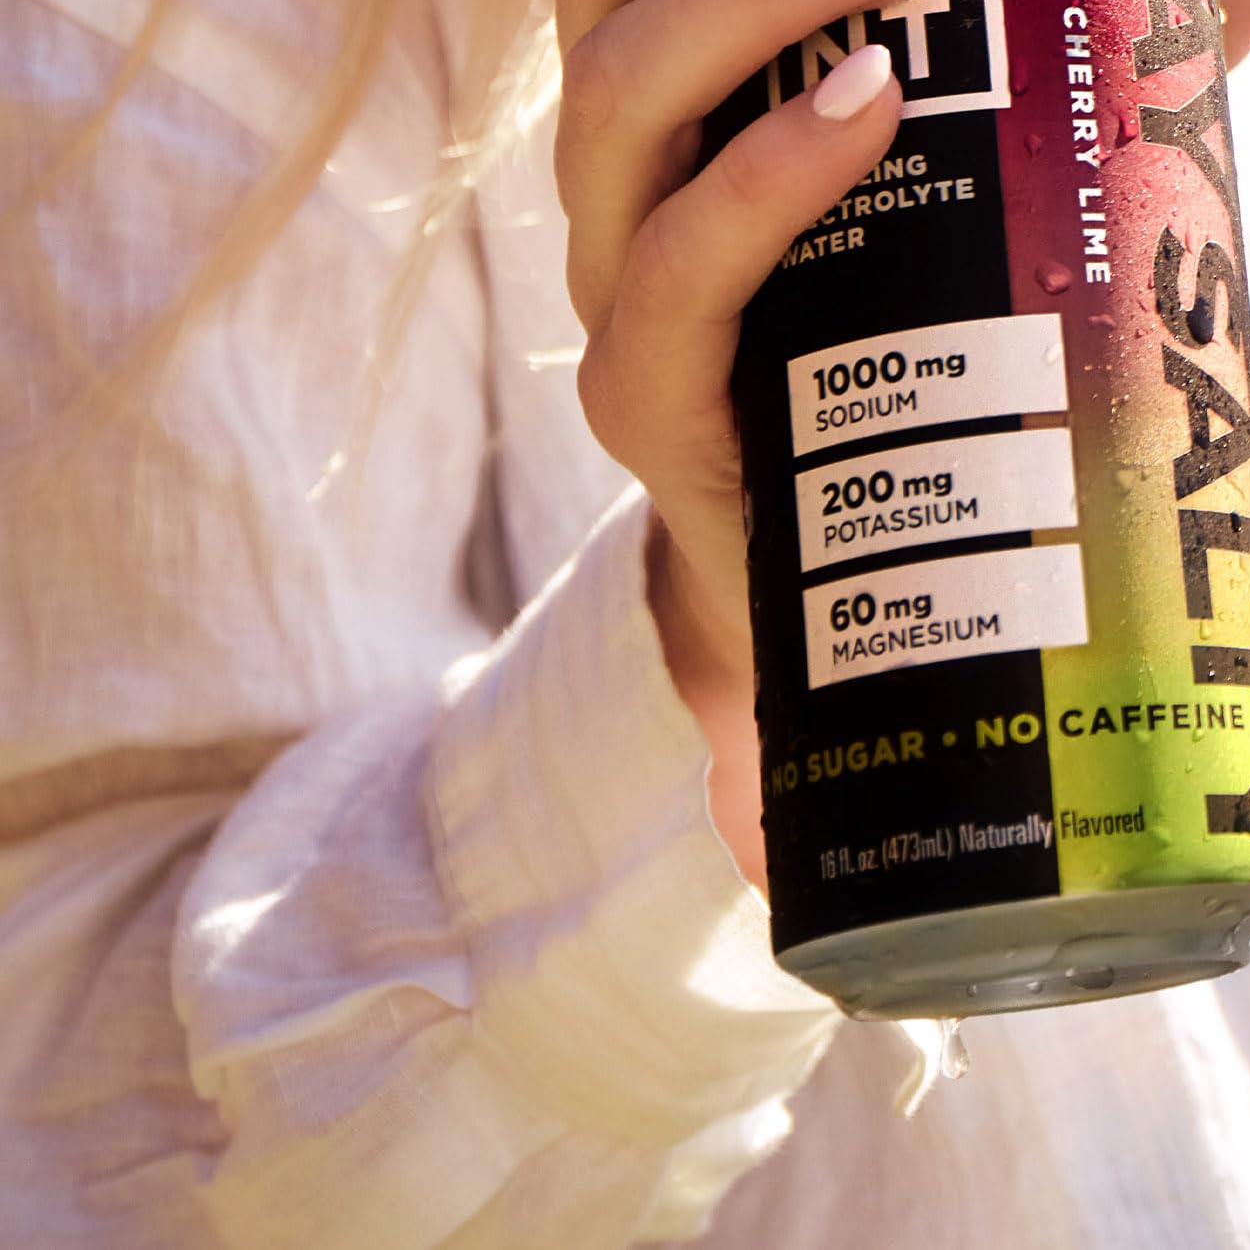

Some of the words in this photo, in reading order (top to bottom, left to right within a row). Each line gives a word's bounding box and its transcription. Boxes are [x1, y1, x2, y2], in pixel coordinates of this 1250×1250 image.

[1063, 6, 1102, 170] CHERRY
[1078, 187, 1111, 284] LIME
[813, 351, 906, 400] 1000
[915, 354, 966, 378] mg
[815, 389, 918, 432] SODIUM
[821, 470, 895, 516] 200
[902, 472, 953, 498] mg
[824, 497, 978, 548] POTASSIUM
[830, 592, 876, 632] 60
[883, 594, 932, 620] mg
[832, 613, 1001, 666] MAGNESIUM
[771, 761, 799, 797] NO
[807, 730, 925, 783] SUGAR
[975, 712, 1041, 749] NO
[1058, 703, 1246, 738] CAFFEINE
[819, 848, 837, 880] 16
[881, 827, 953, 872] (473mL)
[958, 813, 1053, 854] Naturally
[1059, 804, 1146, 839] Flavored
